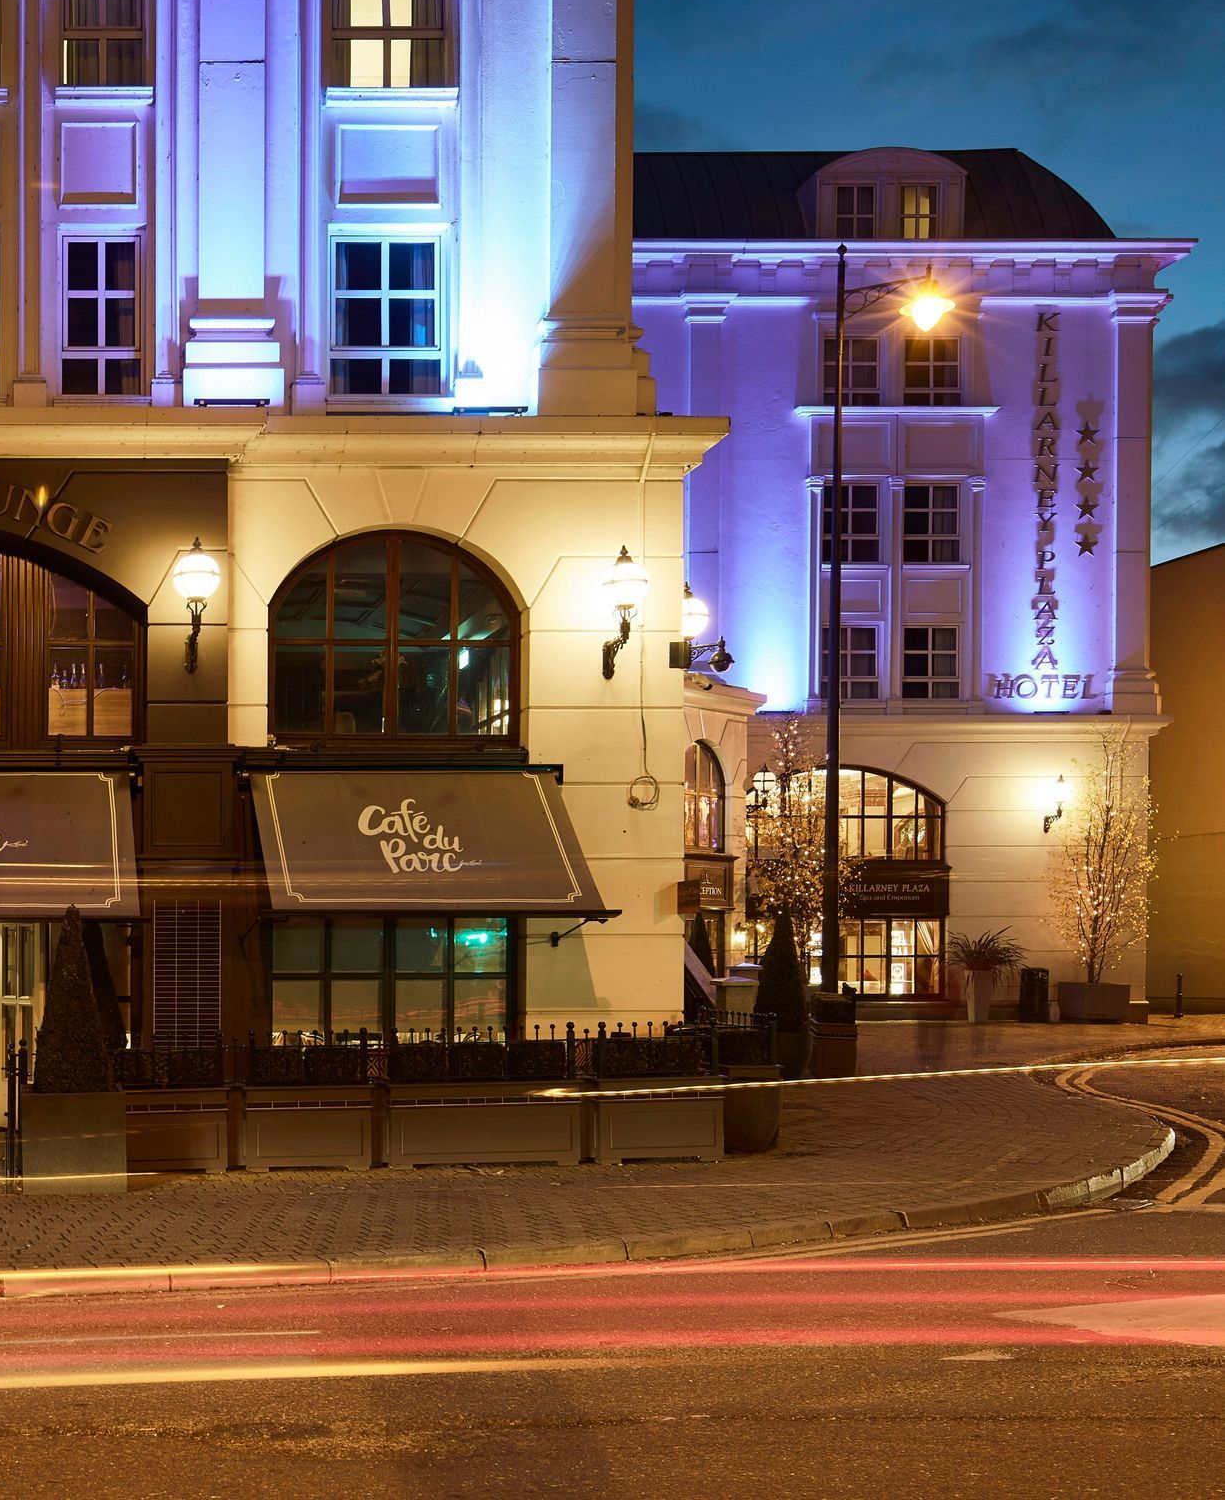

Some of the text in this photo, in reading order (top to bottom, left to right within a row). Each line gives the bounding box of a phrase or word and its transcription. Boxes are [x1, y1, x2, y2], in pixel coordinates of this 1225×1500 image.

[1033, 312, 1061, 670] KILLARNEY PLAZA
[993, 678, 1097, 699] HOTEL
[358, 799, 430, 842] Café
[423, 825, 464, 852] du
[380, 838, 464, 874] Parc
[849, 884, 931, 893] KILLARNEY PLAZA
